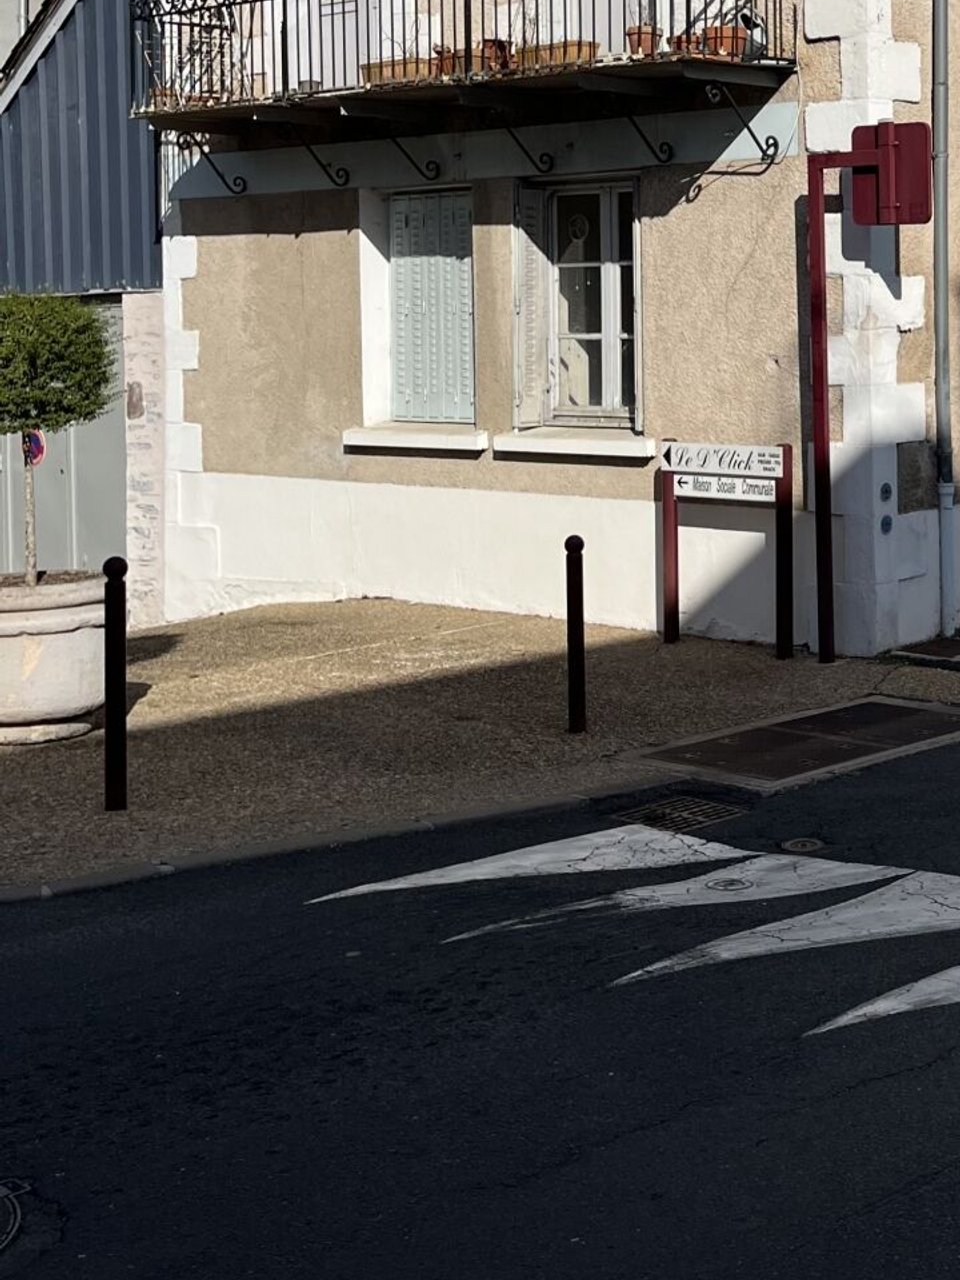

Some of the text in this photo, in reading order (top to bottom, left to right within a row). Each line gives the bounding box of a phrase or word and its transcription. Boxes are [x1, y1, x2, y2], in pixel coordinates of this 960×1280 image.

[675, 446, 693, 468] Le
[692, 476, 774, 496] Maison Sociale Communale
